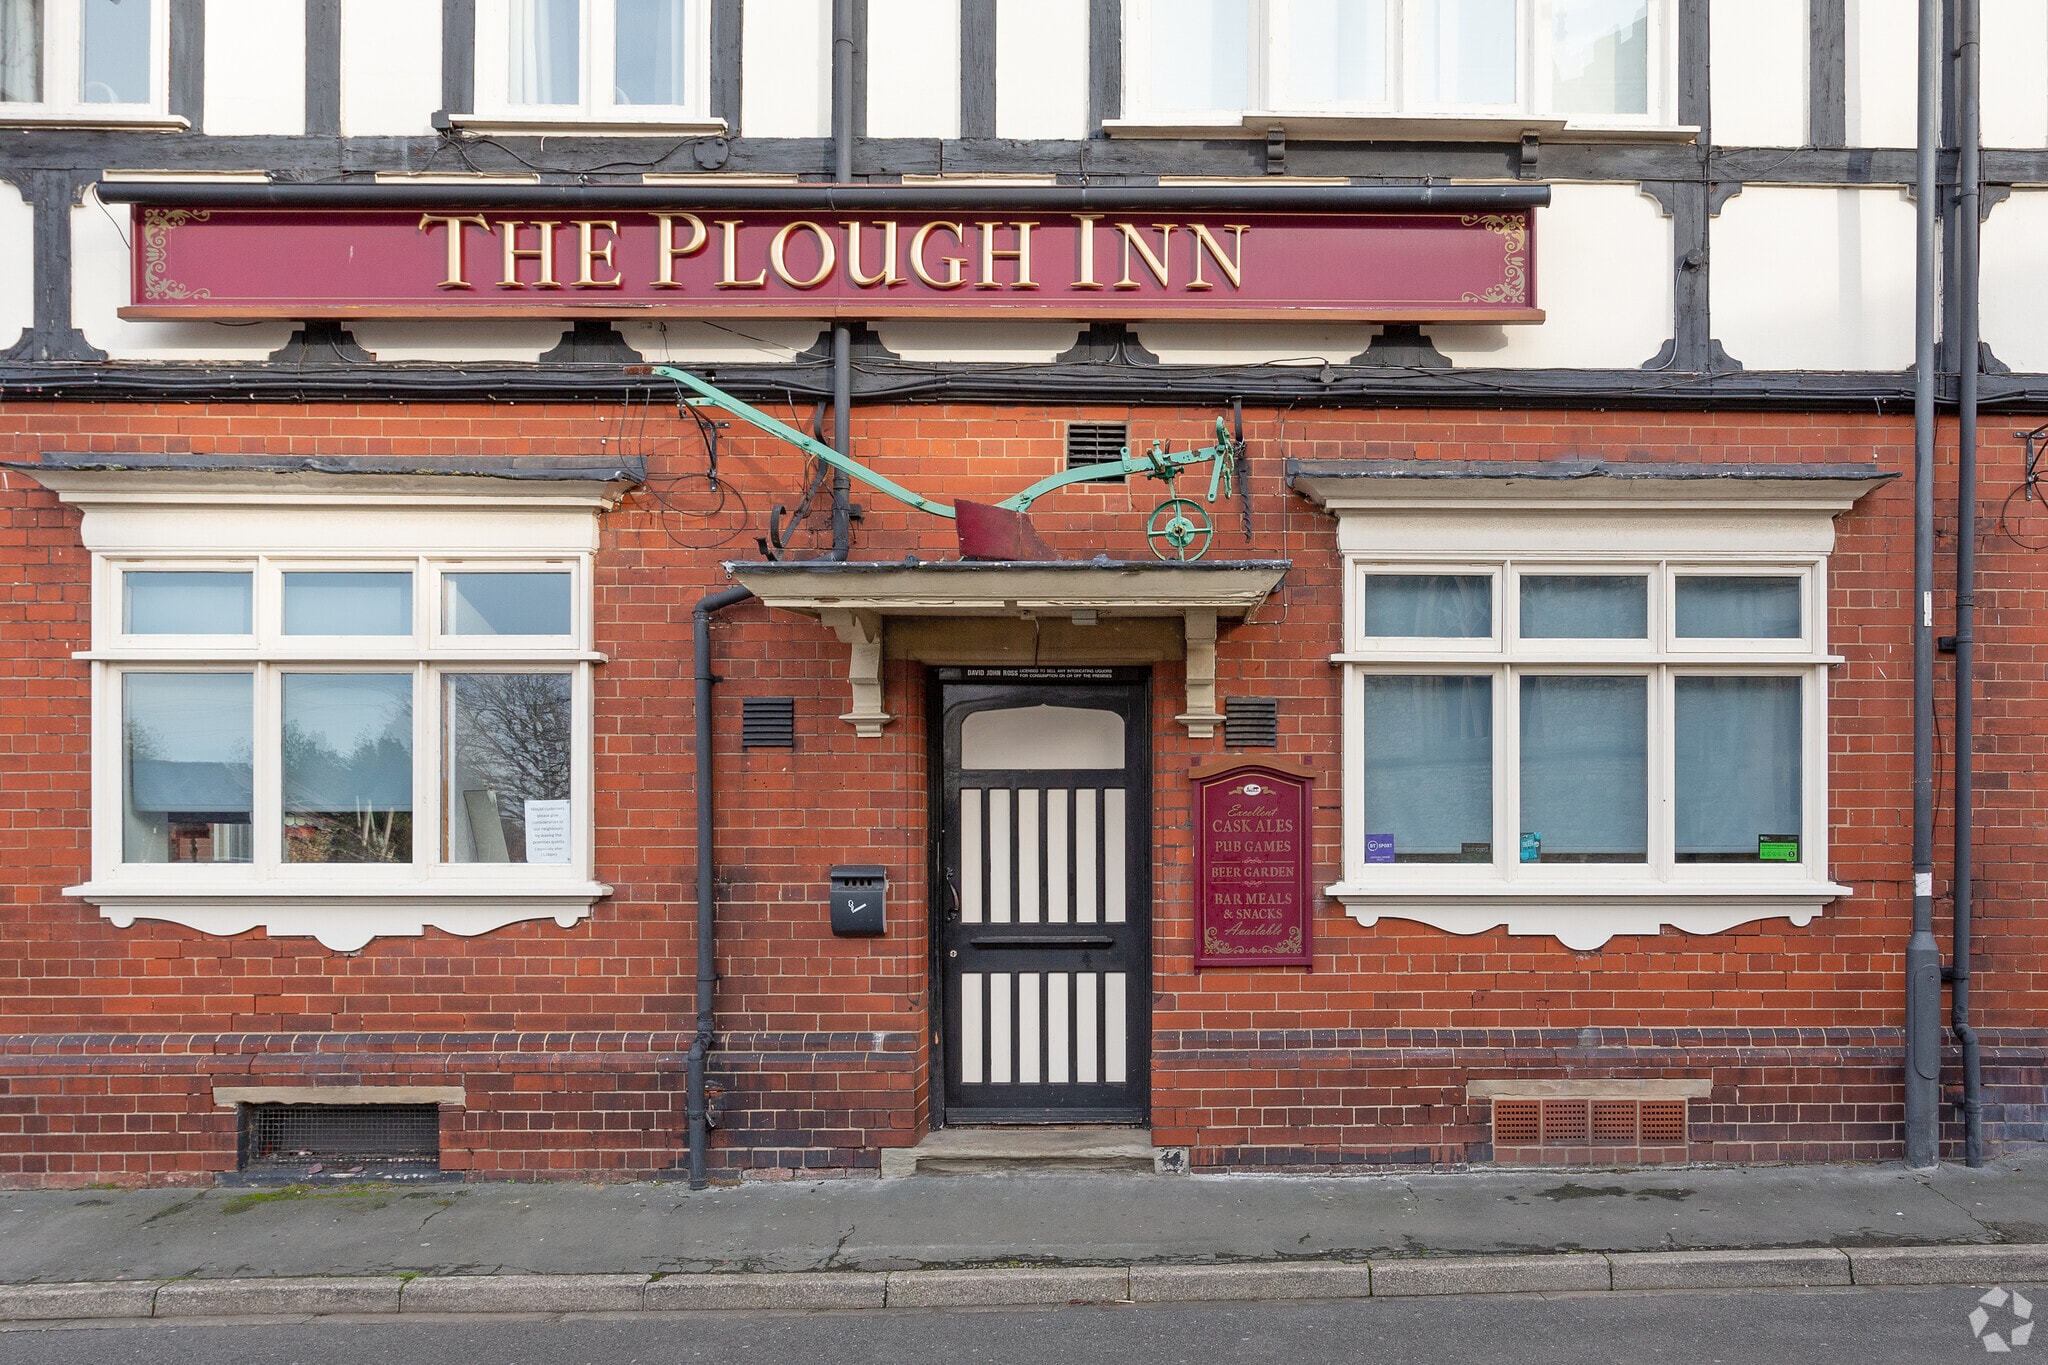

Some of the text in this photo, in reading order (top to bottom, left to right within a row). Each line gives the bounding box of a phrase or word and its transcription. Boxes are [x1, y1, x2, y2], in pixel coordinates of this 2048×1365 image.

[418, 213, 1251, 288] THE PLOUGH INN
[1002, 669, 1019, 677] ROSS
[1227, 803, 1279, 818] Excellent
[1212, 818, 1293, 833] CASK ALES
[1215, 840, 1291, 853] PUB GAMES
[1211, 866, 1294, 878] BEER GARDEN
[1215, 893, 1292, 905] BAR MEALS
[1223, 908, 1283, 919] & SNACKS
[1224, 921, 1283, 936] Available
